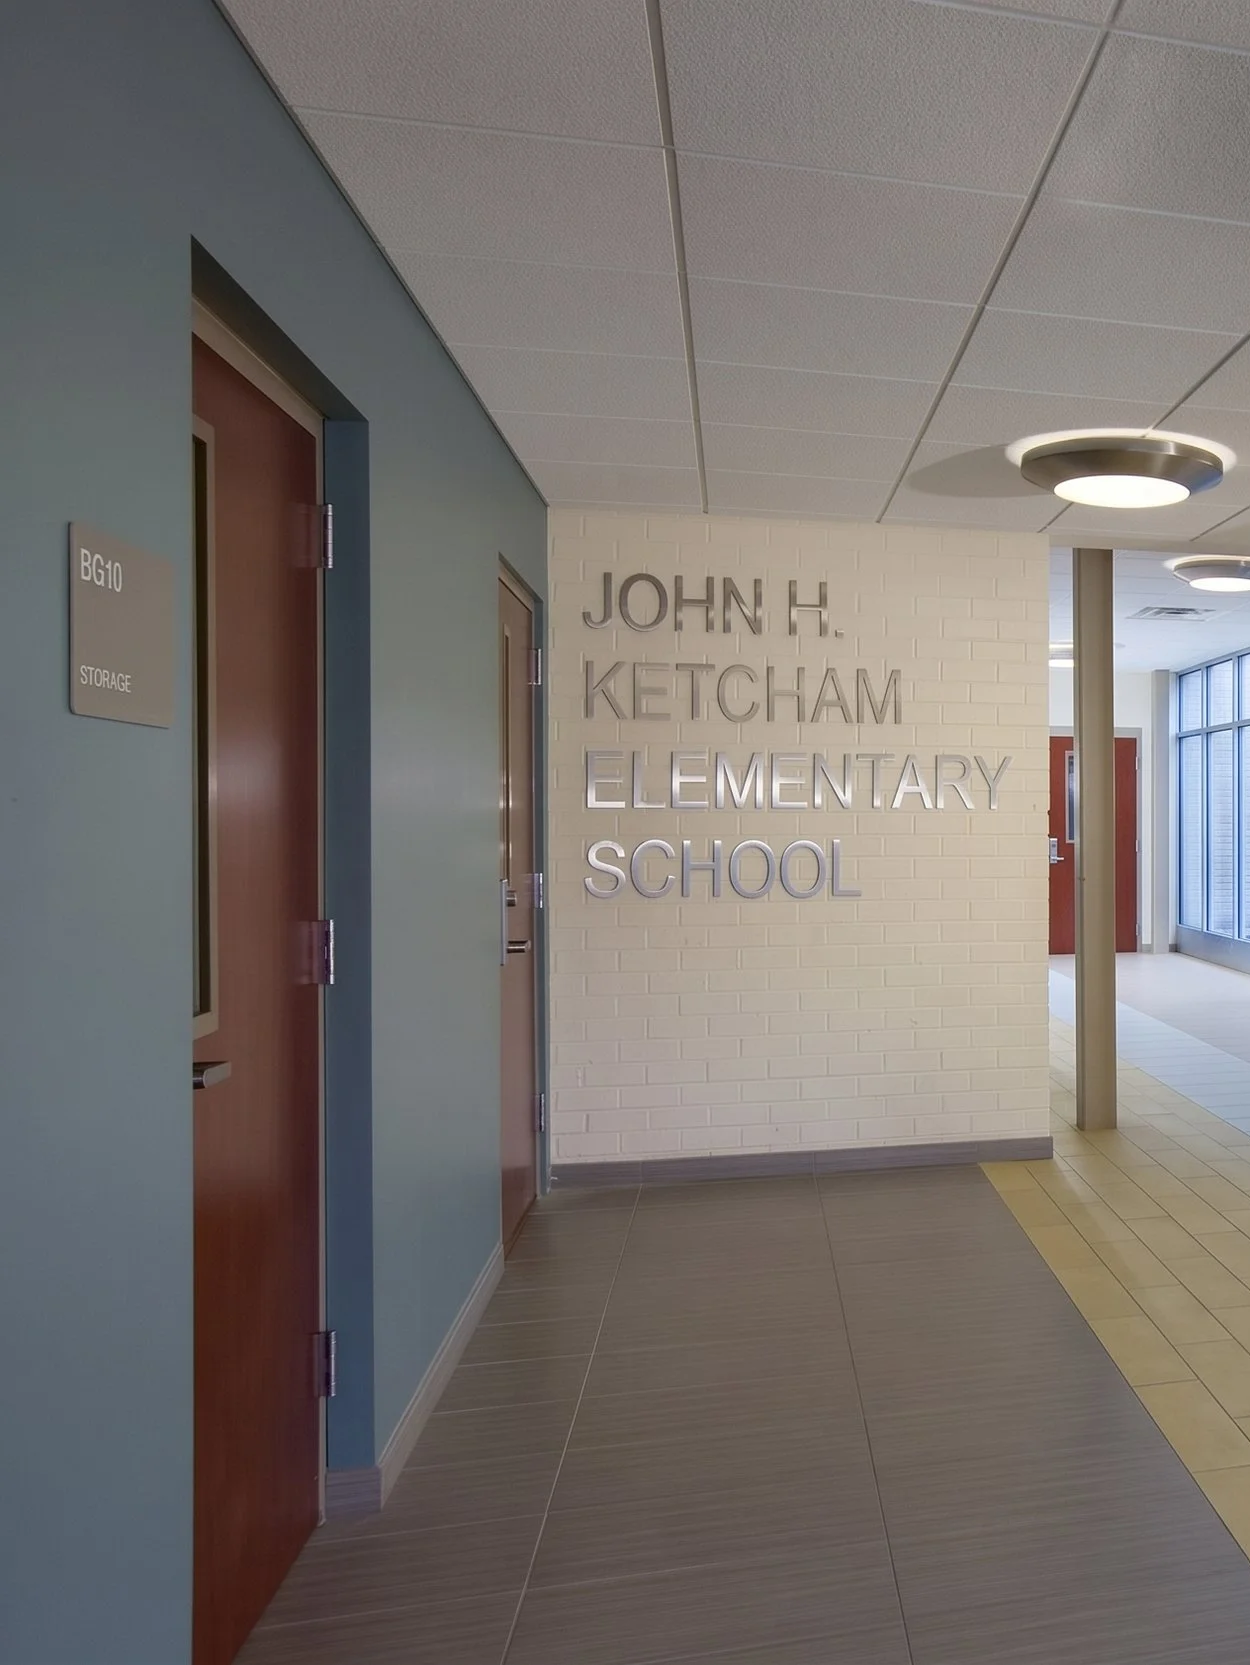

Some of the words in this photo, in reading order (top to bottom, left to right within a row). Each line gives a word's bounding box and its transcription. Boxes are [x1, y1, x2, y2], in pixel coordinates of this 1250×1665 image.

[80, 548, 123, 592] BG10
[582, 572, 763, 635] JOHN
[788, 579, 845, 638] H.
[80, 664, 132, 693] STORAGE
[584, 660, 902, 724] KETCHAM
[585, 751, 1014, 810] ELEMENTARY
[583, 839, 862, 899] SCHOOL
